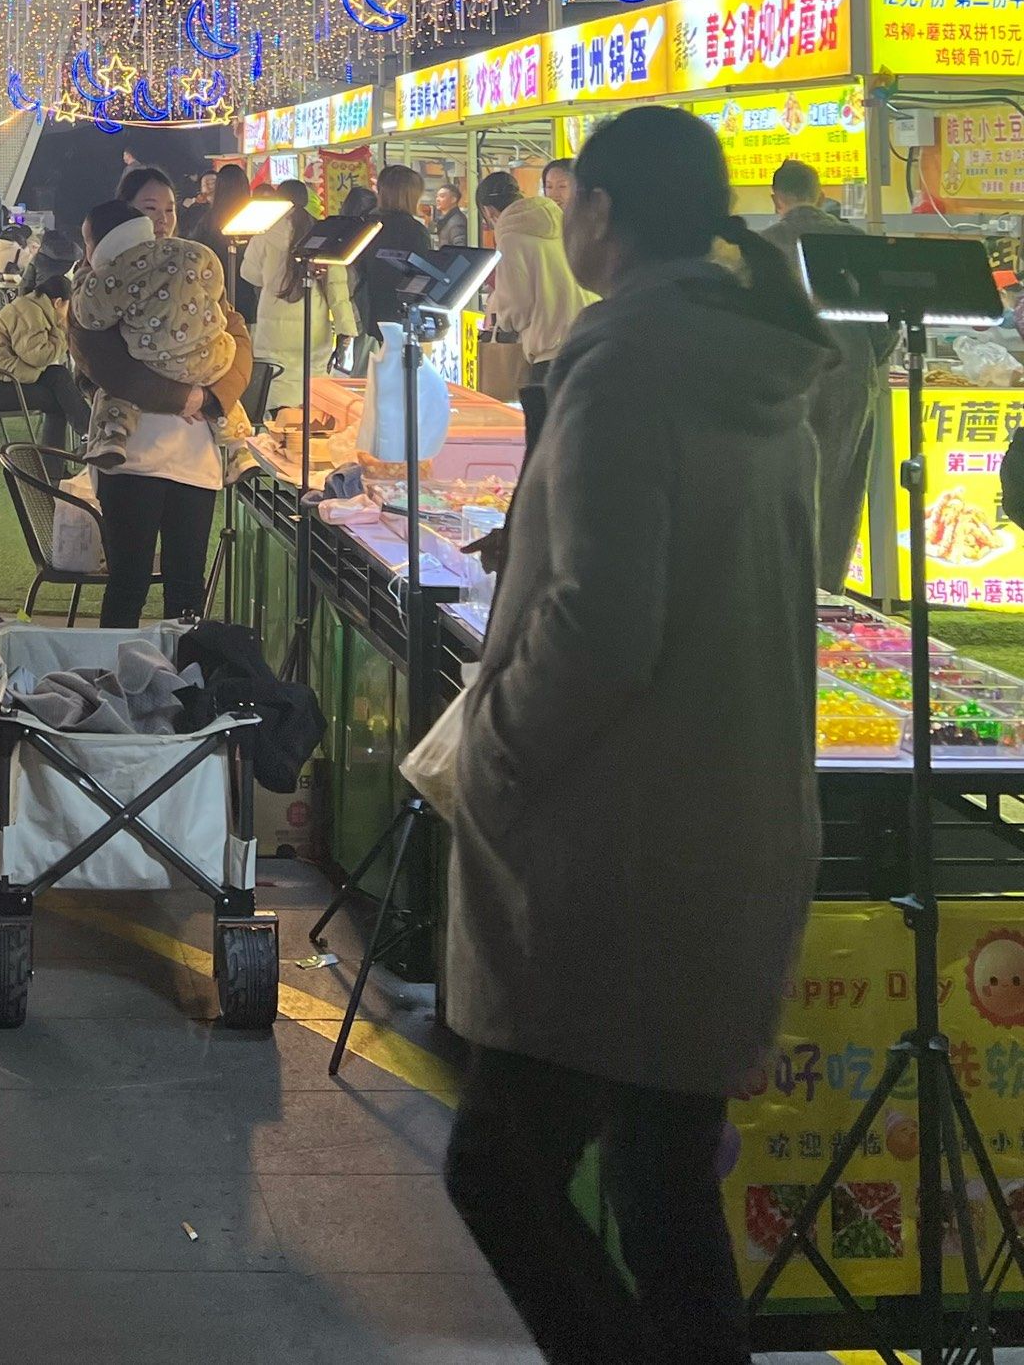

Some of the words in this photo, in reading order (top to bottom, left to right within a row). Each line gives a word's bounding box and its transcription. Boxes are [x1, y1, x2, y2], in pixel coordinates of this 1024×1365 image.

[570, 28, 648, 90] 荆州锅盔
[946, 114, 1024, 145] 脆皮小土豆
[927, 579, 1024, 604] 鸡柳+蘑菇
[781, 975, 870, 1008] appy
[886, 971, 953, 1008] Dy
